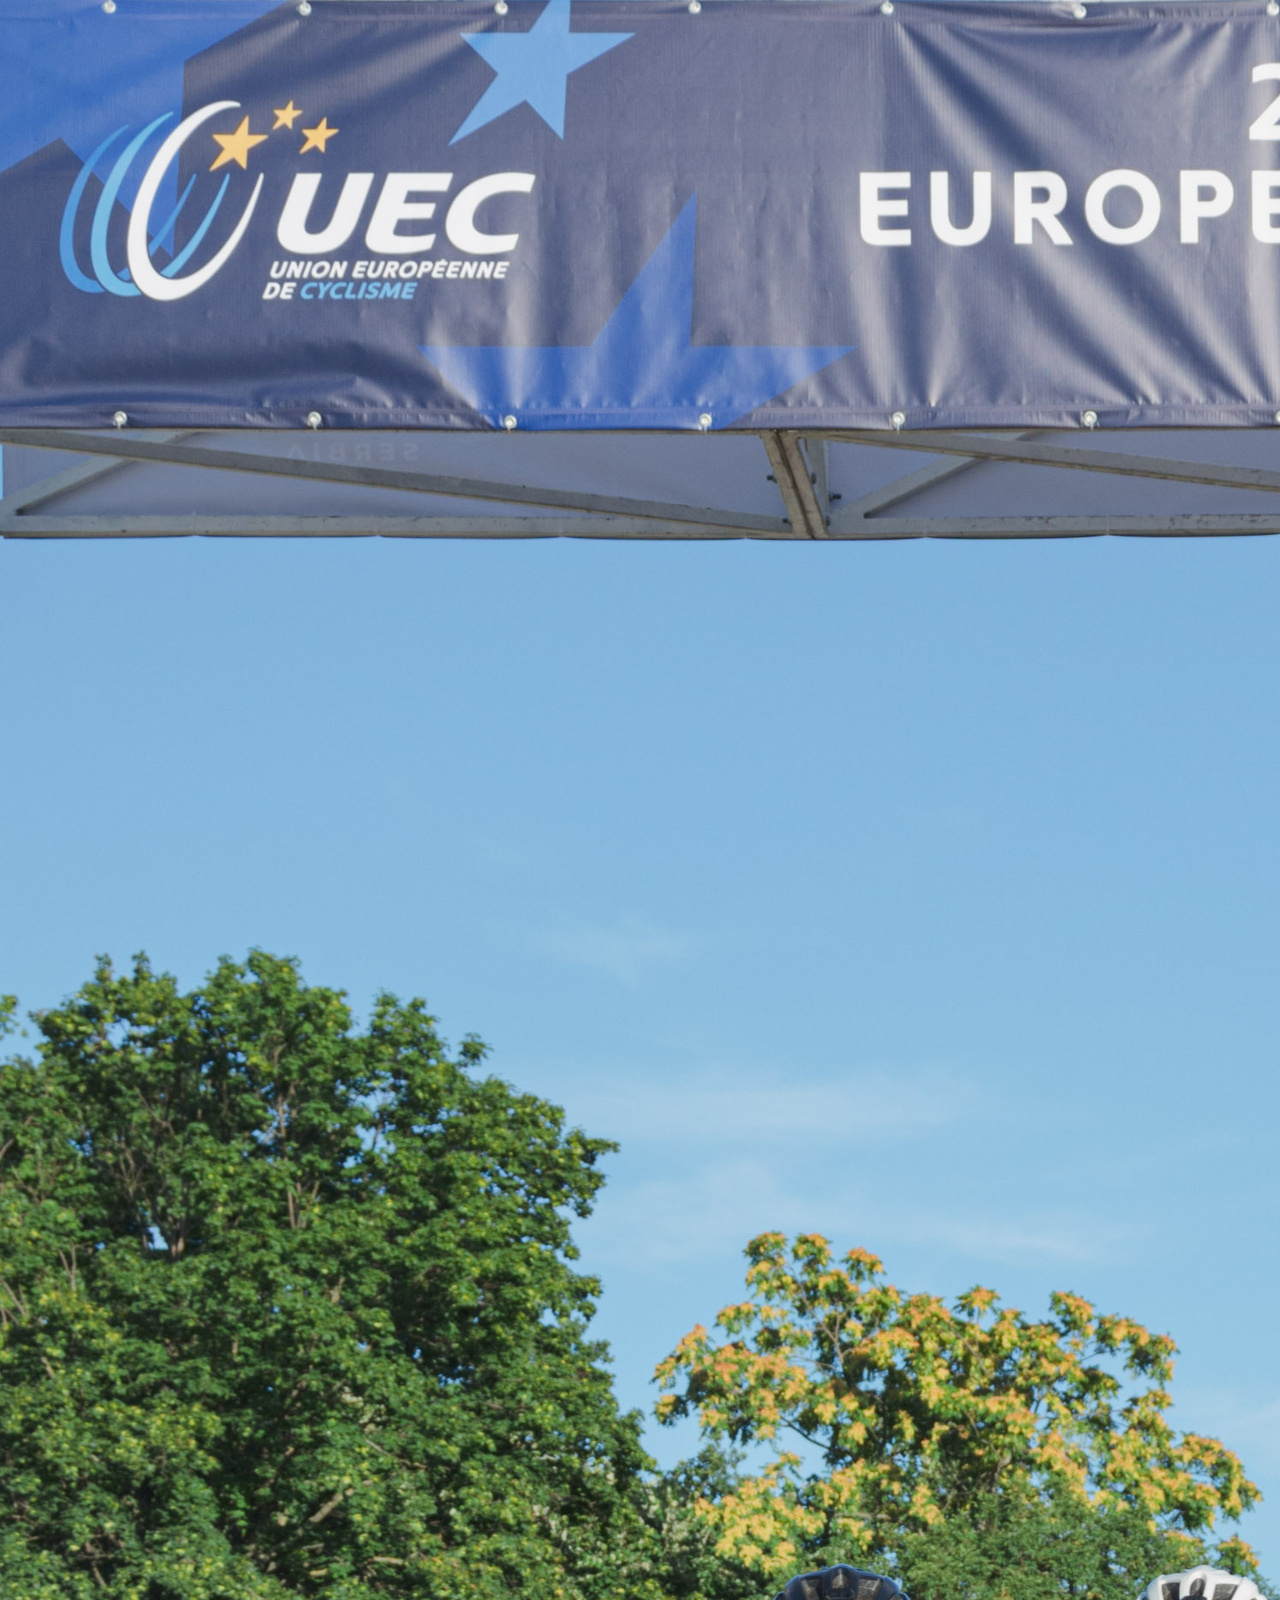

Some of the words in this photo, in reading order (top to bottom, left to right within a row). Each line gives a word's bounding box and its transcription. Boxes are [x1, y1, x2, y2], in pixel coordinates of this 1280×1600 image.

[277, 172, 536, 254] UEC
[270, 260, 347, 279] UNION
[352, 257, 510, 280] EUROPÉENNE
[262, 282, 296, 300] DE
[300, 281, 418, 300] CYCLISME
